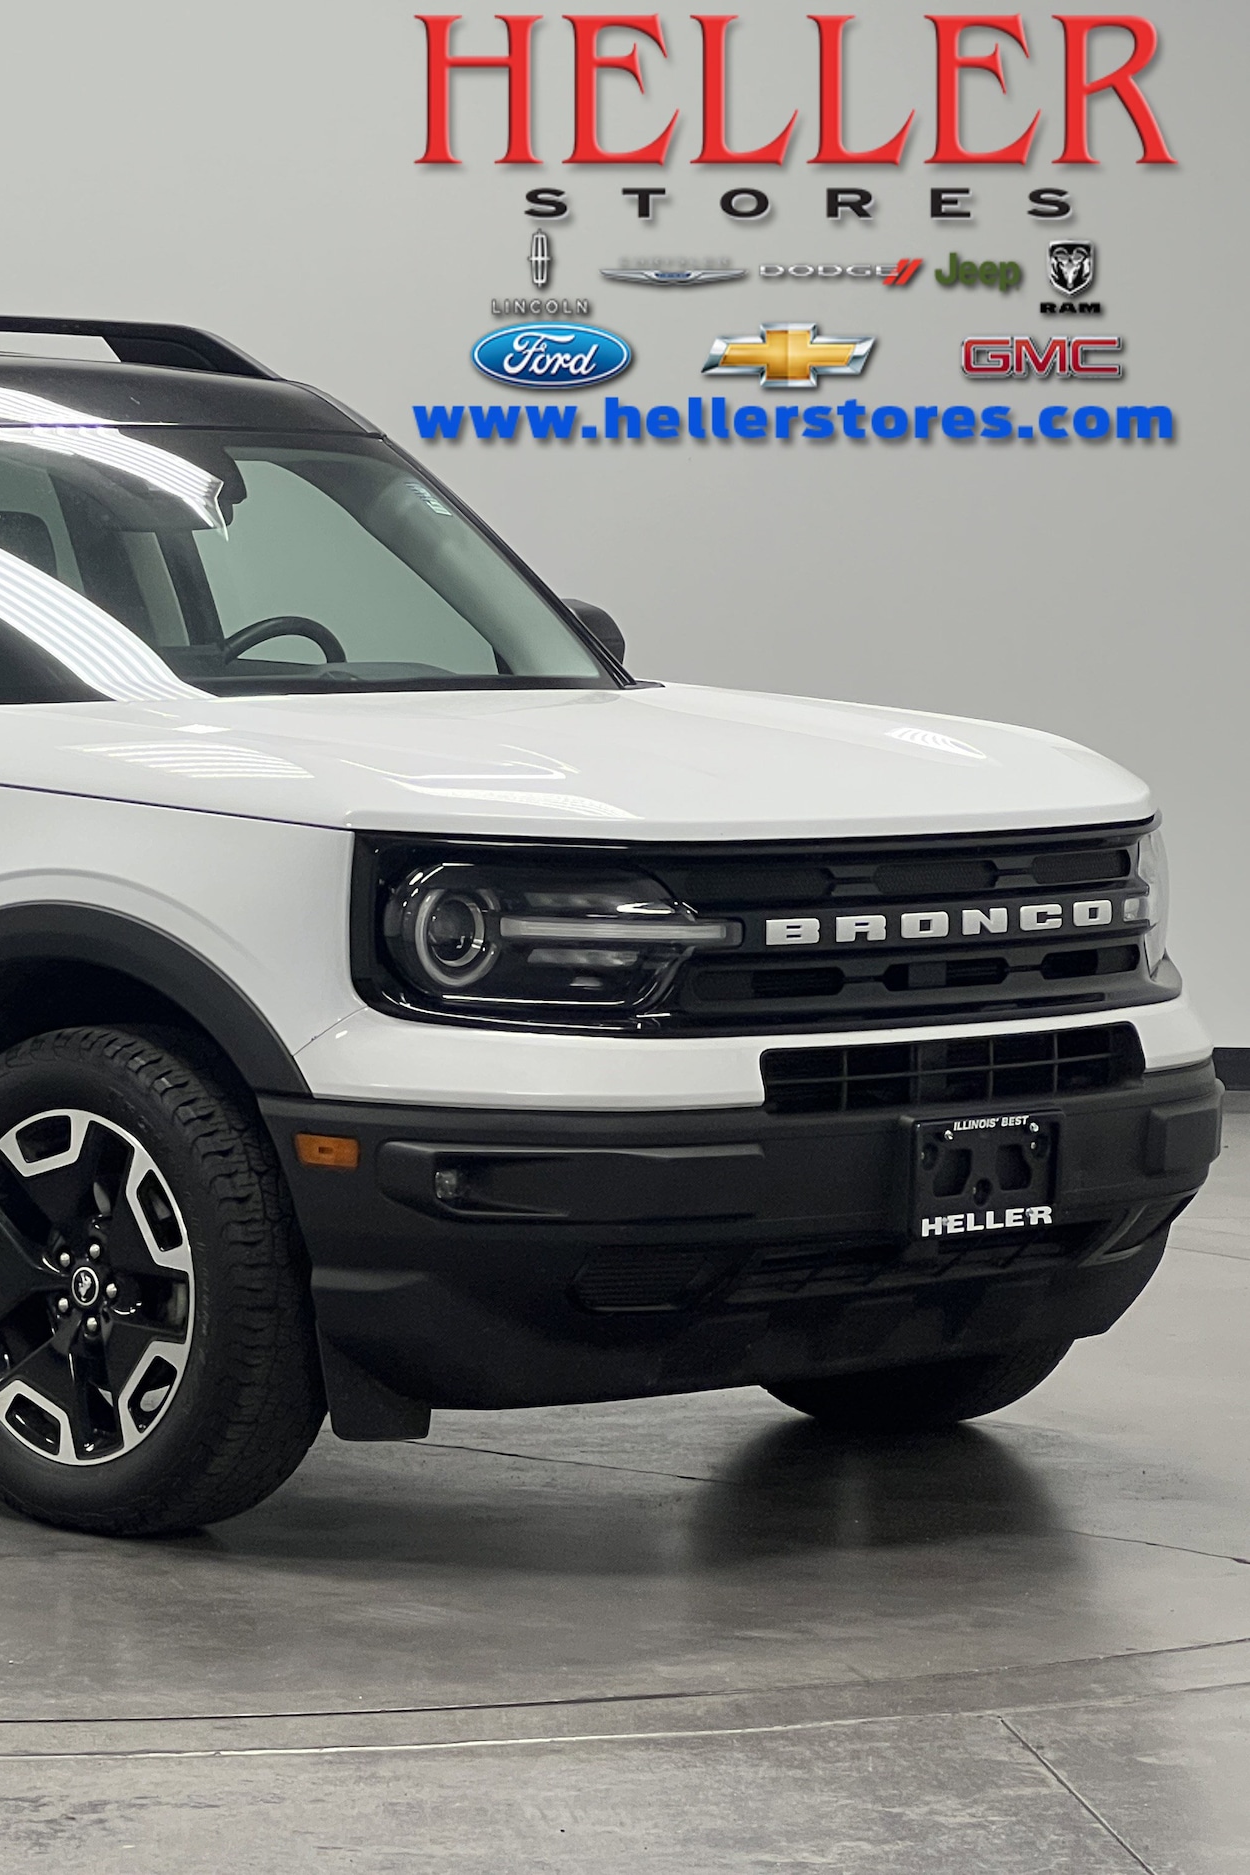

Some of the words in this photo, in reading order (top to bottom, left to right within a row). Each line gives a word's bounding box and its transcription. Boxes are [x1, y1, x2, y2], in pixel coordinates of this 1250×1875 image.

[765, 900, 1112, 945] BRONCO
[1001, 1115, 1029, 1127] BEST
[921, 1205, 1052, 1237] HELLER
